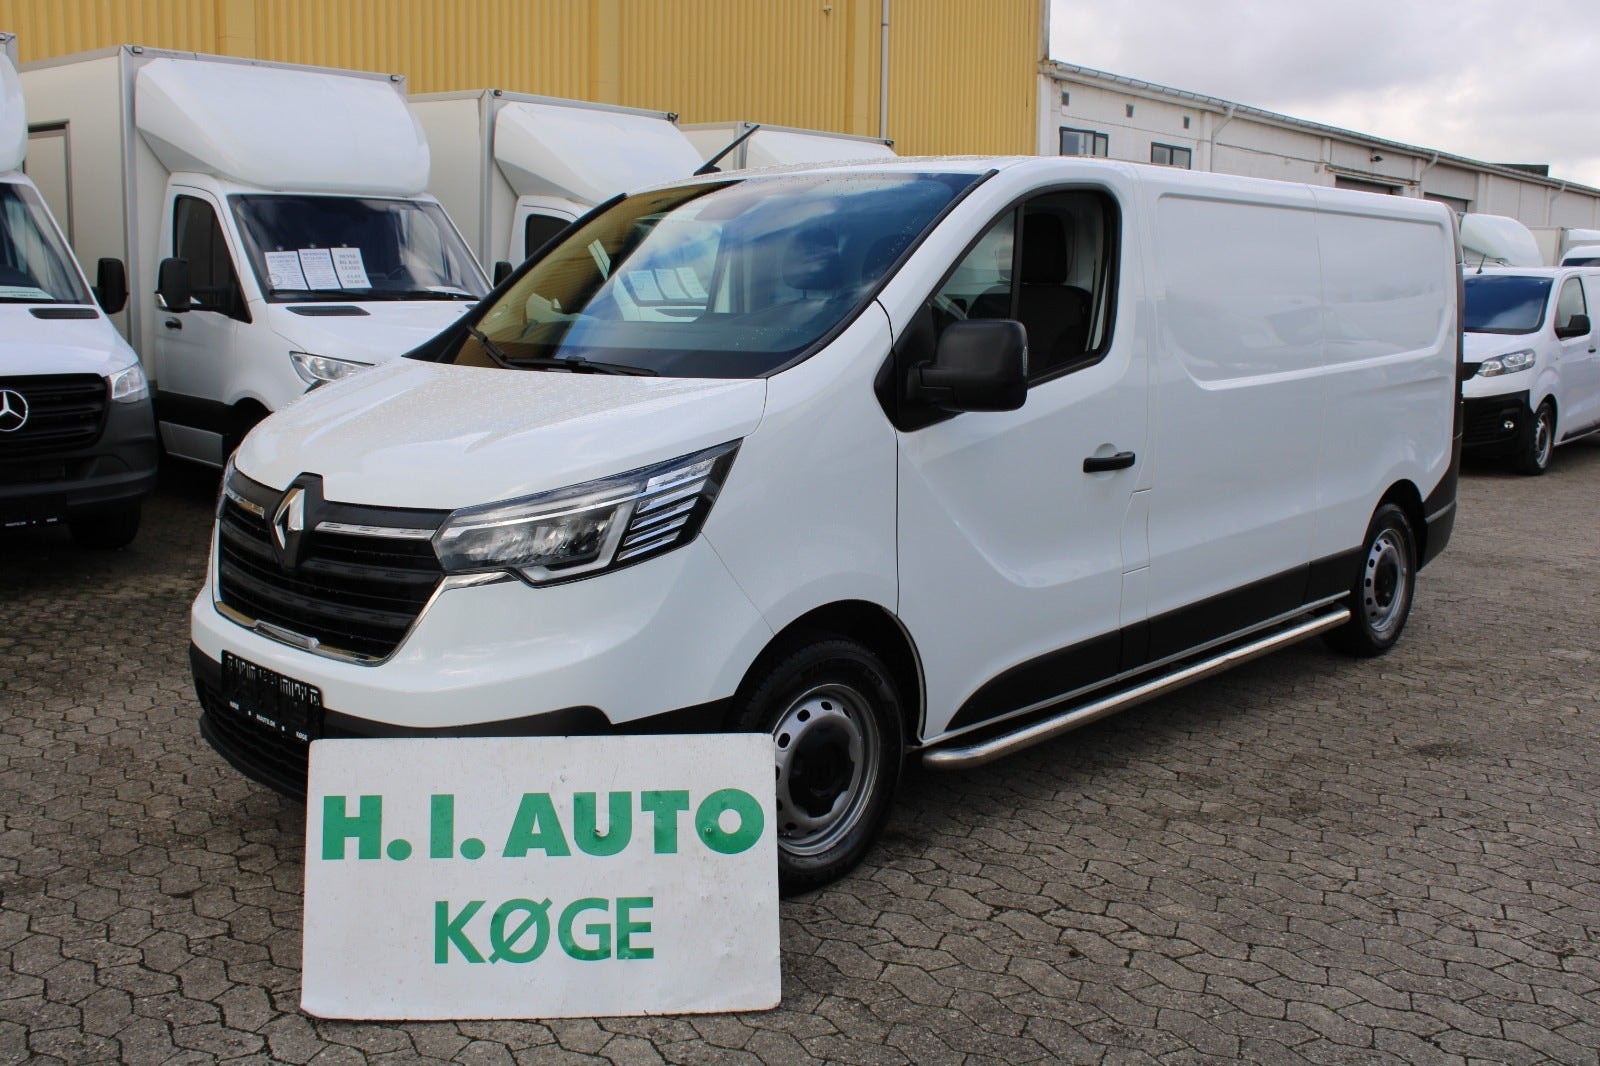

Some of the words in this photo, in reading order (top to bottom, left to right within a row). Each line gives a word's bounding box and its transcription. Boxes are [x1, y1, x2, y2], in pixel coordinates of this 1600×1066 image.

[322, 795, 412, 861] H.
[430, 794, 486, 860] I.
[502, 788, 764, 857] AUTO
[434, 897, 654, 964] KØGE
